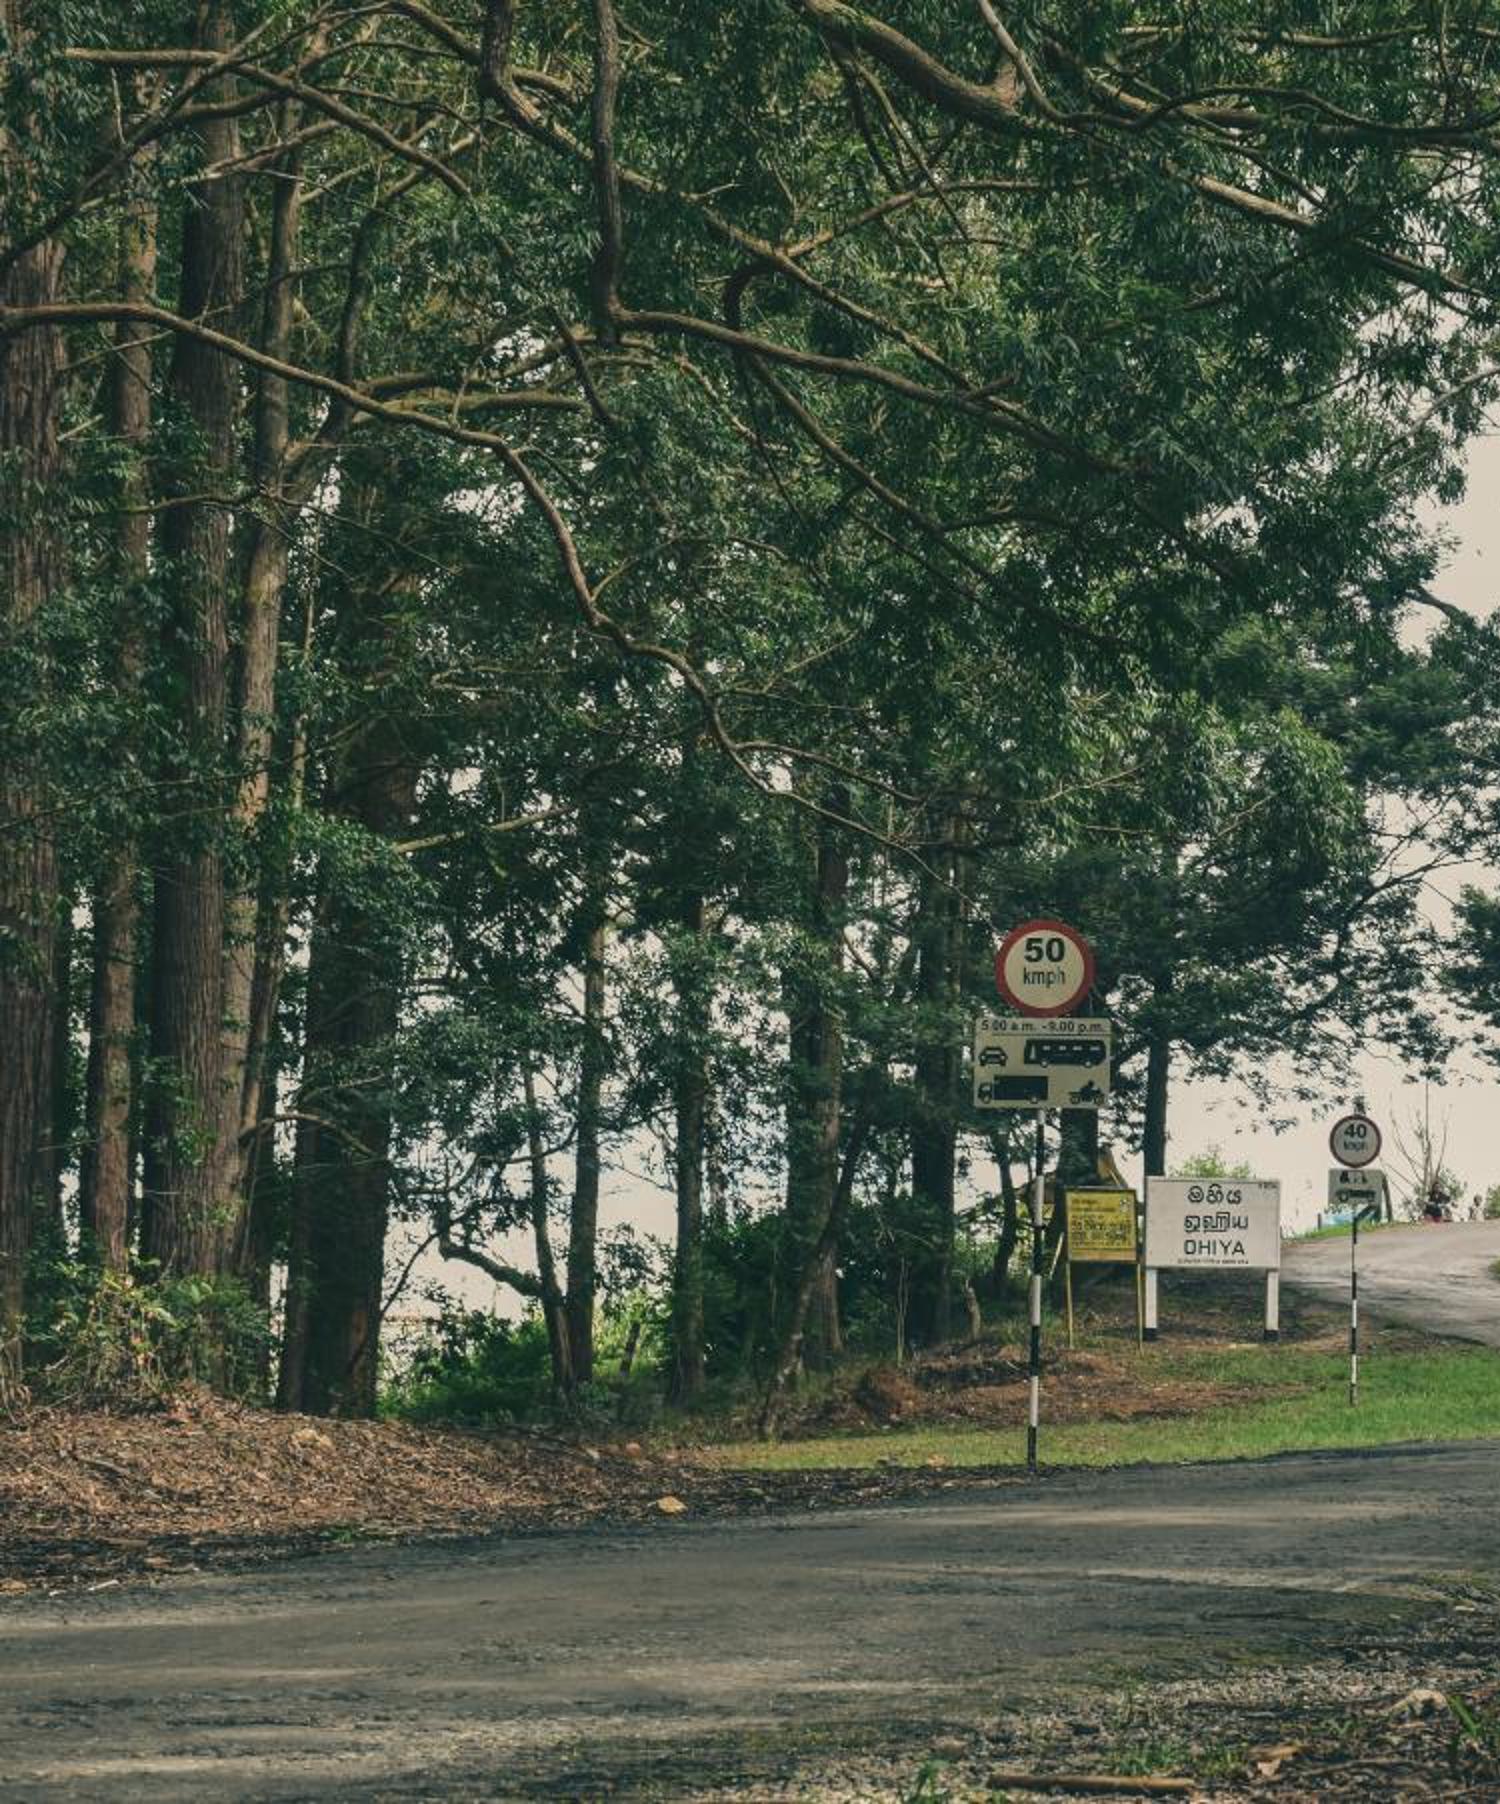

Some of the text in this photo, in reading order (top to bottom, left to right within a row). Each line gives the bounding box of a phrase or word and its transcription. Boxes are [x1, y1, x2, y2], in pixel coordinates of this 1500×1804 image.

[1024, 938, 1065, 962] 50
[1023, 967, 1065, 988] kmph
[1343, 1123, 1367, 1138] 40
[1184, 1239, 1245, 1255] OHIYA
